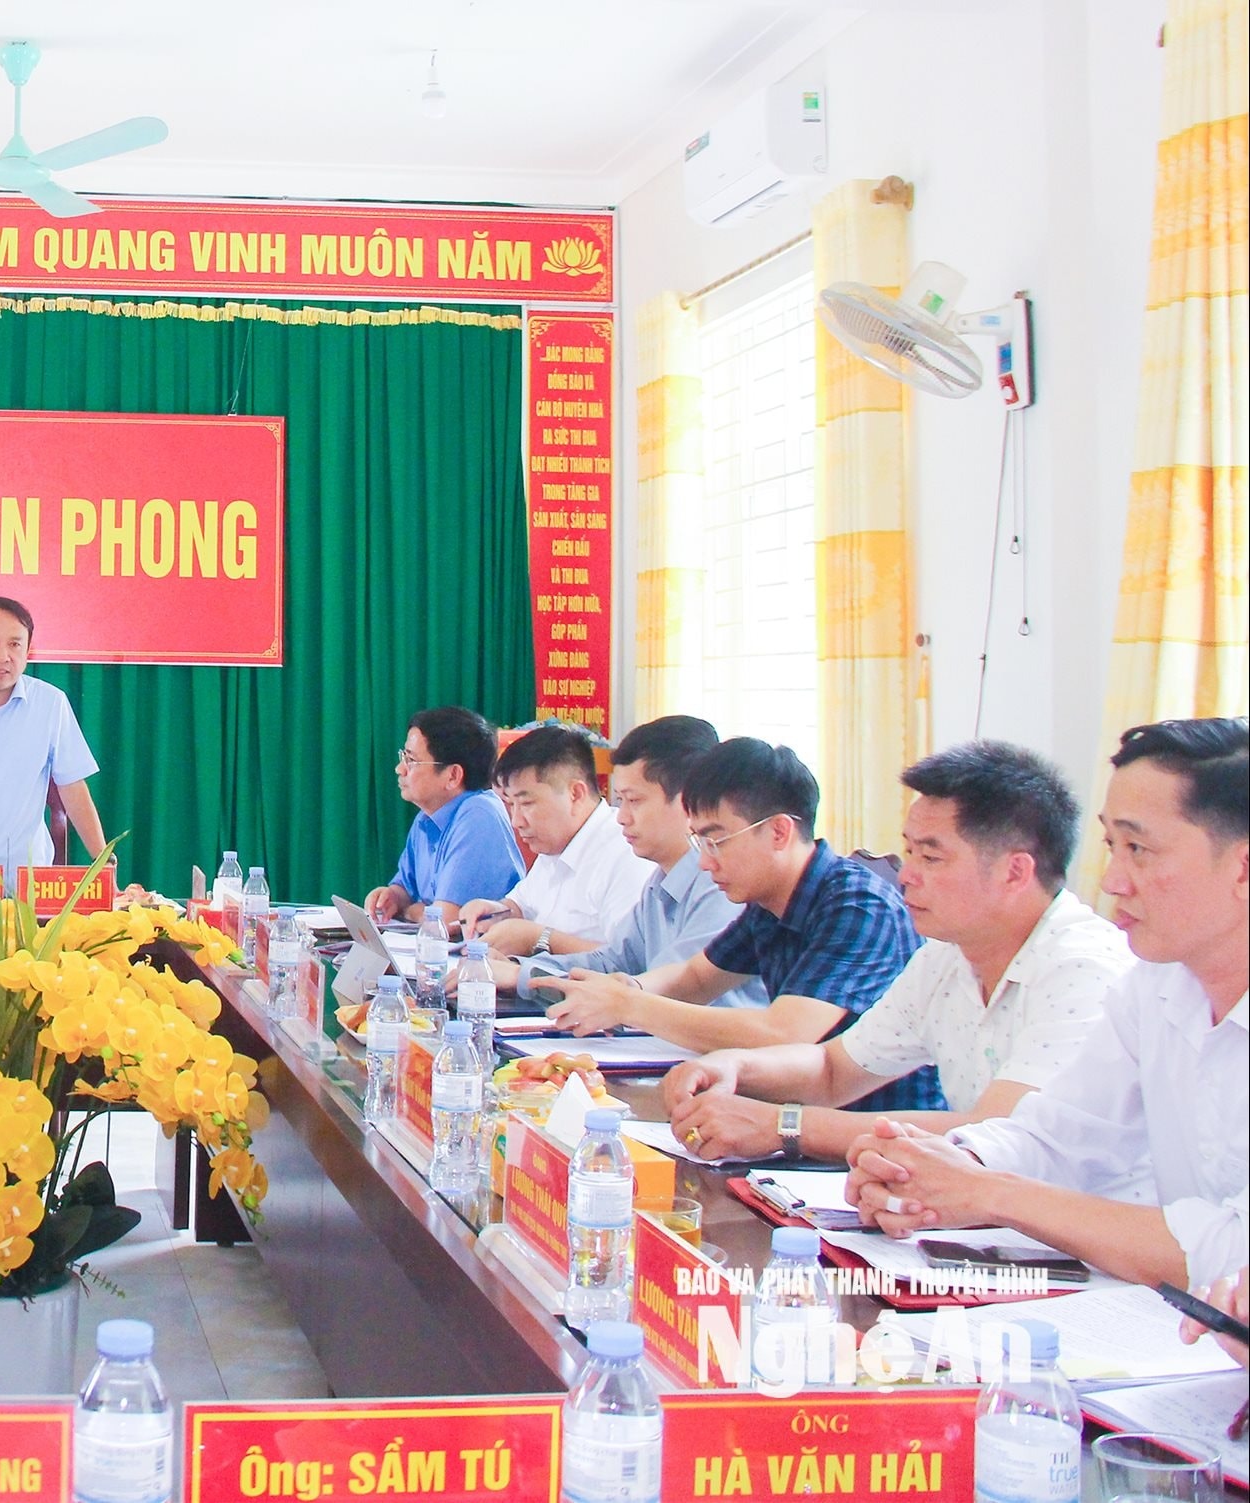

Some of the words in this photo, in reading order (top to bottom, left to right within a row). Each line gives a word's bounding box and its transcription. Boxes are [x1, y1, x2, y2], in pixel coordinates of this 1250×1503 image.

[33, 227, 175, 273] QUANG
[189, 231, 285, 274] VINH
[301, 228, 423, 278] MUÔN
[437, 230, 531, 281] NĂM
[60, 498, 258, 580] PHONG
[791, 1409, 849, 1435] ÔNG
[239, 1445, 333, 1501] Ông:
[349, 1436, 446, 1496] SẦM
[460, 1439, 511, 1491] TÚ
[693, 1447, 752, 1497] HÀ
[767, 1446, 855, 1496] VĂN
[870, 1439, 942, 1493] HẢI
